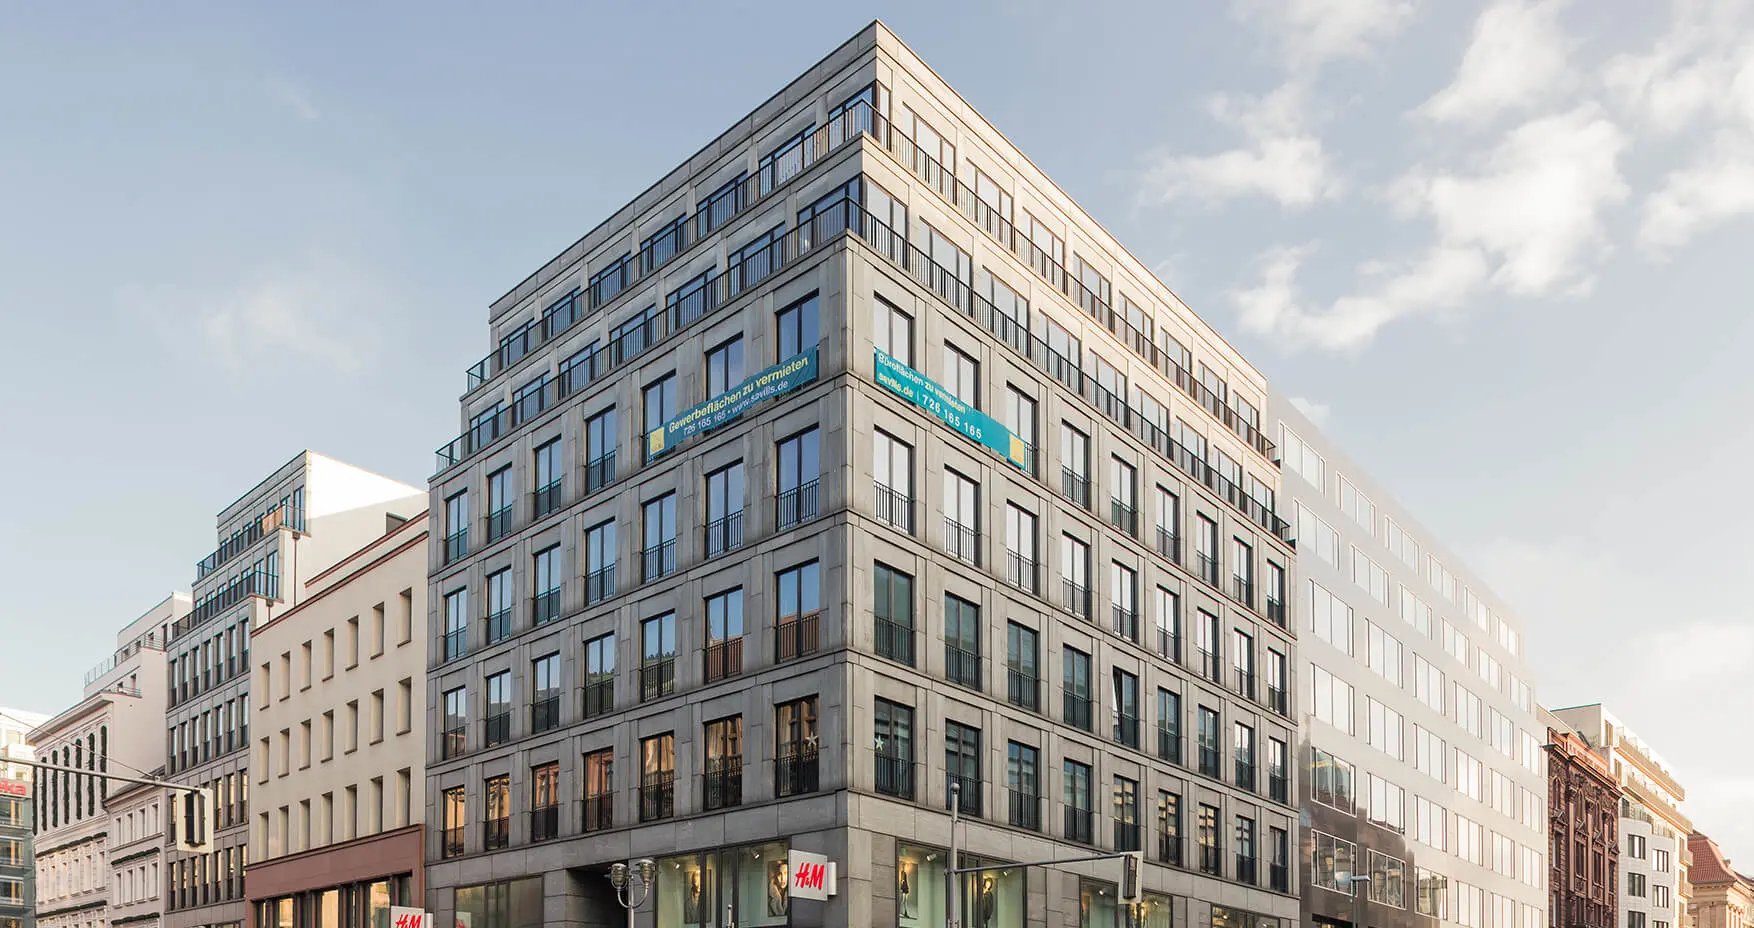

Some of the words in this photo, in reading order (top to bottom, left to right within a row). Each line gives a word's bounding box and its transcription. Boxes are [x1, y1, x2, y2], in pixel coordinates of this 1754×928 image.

[669, 391, 741, 432] Gewerbeflächen
[743, 382, 753, 396] zu
[756, 357, 808, 387] vermieten
[878, 352, 924, 386] Büroflächen
[924, 381, 934, 392] zu
[683, 423, 696, 436] 726
[698, 416, 711, 429] 165
[714, 410, 726, 422] 165
[731, 380, 788, 414] www.savills.de
[878, 372, 914, 397] savills.de
[922, 394, 940, 413] 726
[944, 409, 960, 427] 165
[964, 422, 982, 439] 165
[795, 862, 825, 890] H&M
